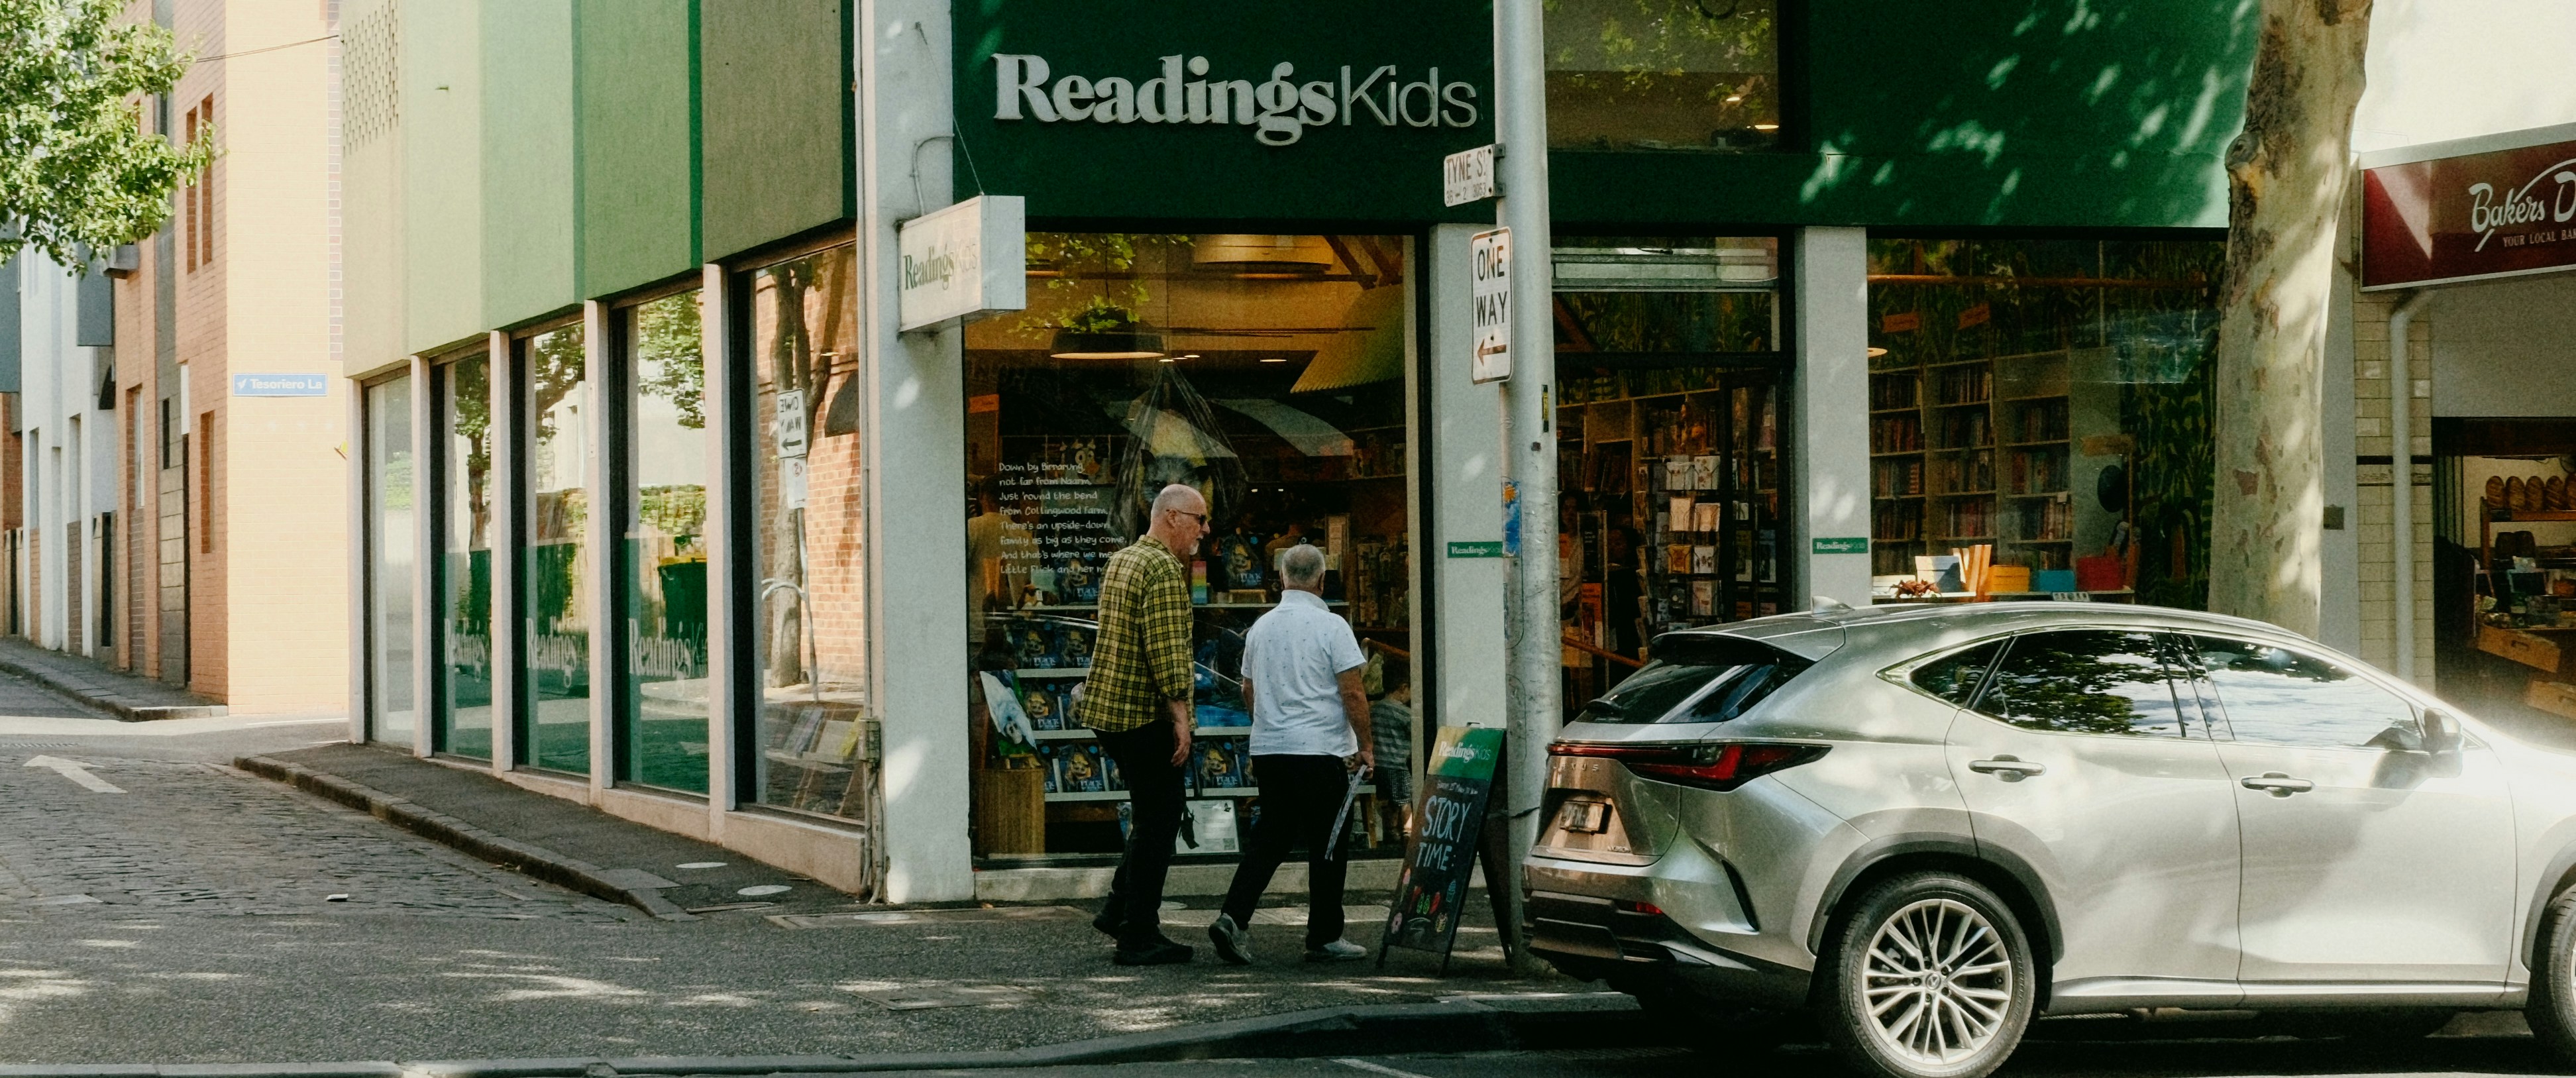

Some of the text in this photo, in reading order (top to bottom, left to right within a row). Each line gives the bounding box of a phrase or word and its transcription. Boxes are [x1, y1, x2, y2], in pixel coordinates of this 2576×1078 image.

[1446, 154, 1472, 185] TYNE
[2469, 182, 2546, 233] Bakers
[2503, 235, 2525, 247] YOUR
[2530, 231, 2556, 244] LOCAL
[1477, 245, 1505, 282] ONE
[1476, 291, 1507, 327] WAY
[250, 378, 323, 390] Tesoriero La
[999, 462, 1024, 472] Down
[1027, 462, 1038, 473] by
[999, 477, 1016, 486] not
[1020, 477, 1034, 486] far
[1036, 476, 1059, 486] from
[999, 492, 1019, 501] Just
[1053, 491, 1071, 500] the
[1074, 491, 1097, 500] bend
[999, 506, 1022, 515] from
[1025, 506, 1082, 517] Collingwood
[1000, 521, 1034, 529] There's
[1051, 520, 1110, 531] upside-down
[1046, 536, 1059, 547] big
[1075, 535, 1097, 545] they
[1001, 551, 1018, 559] And
[1021, 550, 1048, 559] that's
[1051, 550, 1080, 559] where
[1000, 564, 1027, 574] Little
[1057, 565, 1074, 574] and
[1422, 795, 1472, 843] STORY
